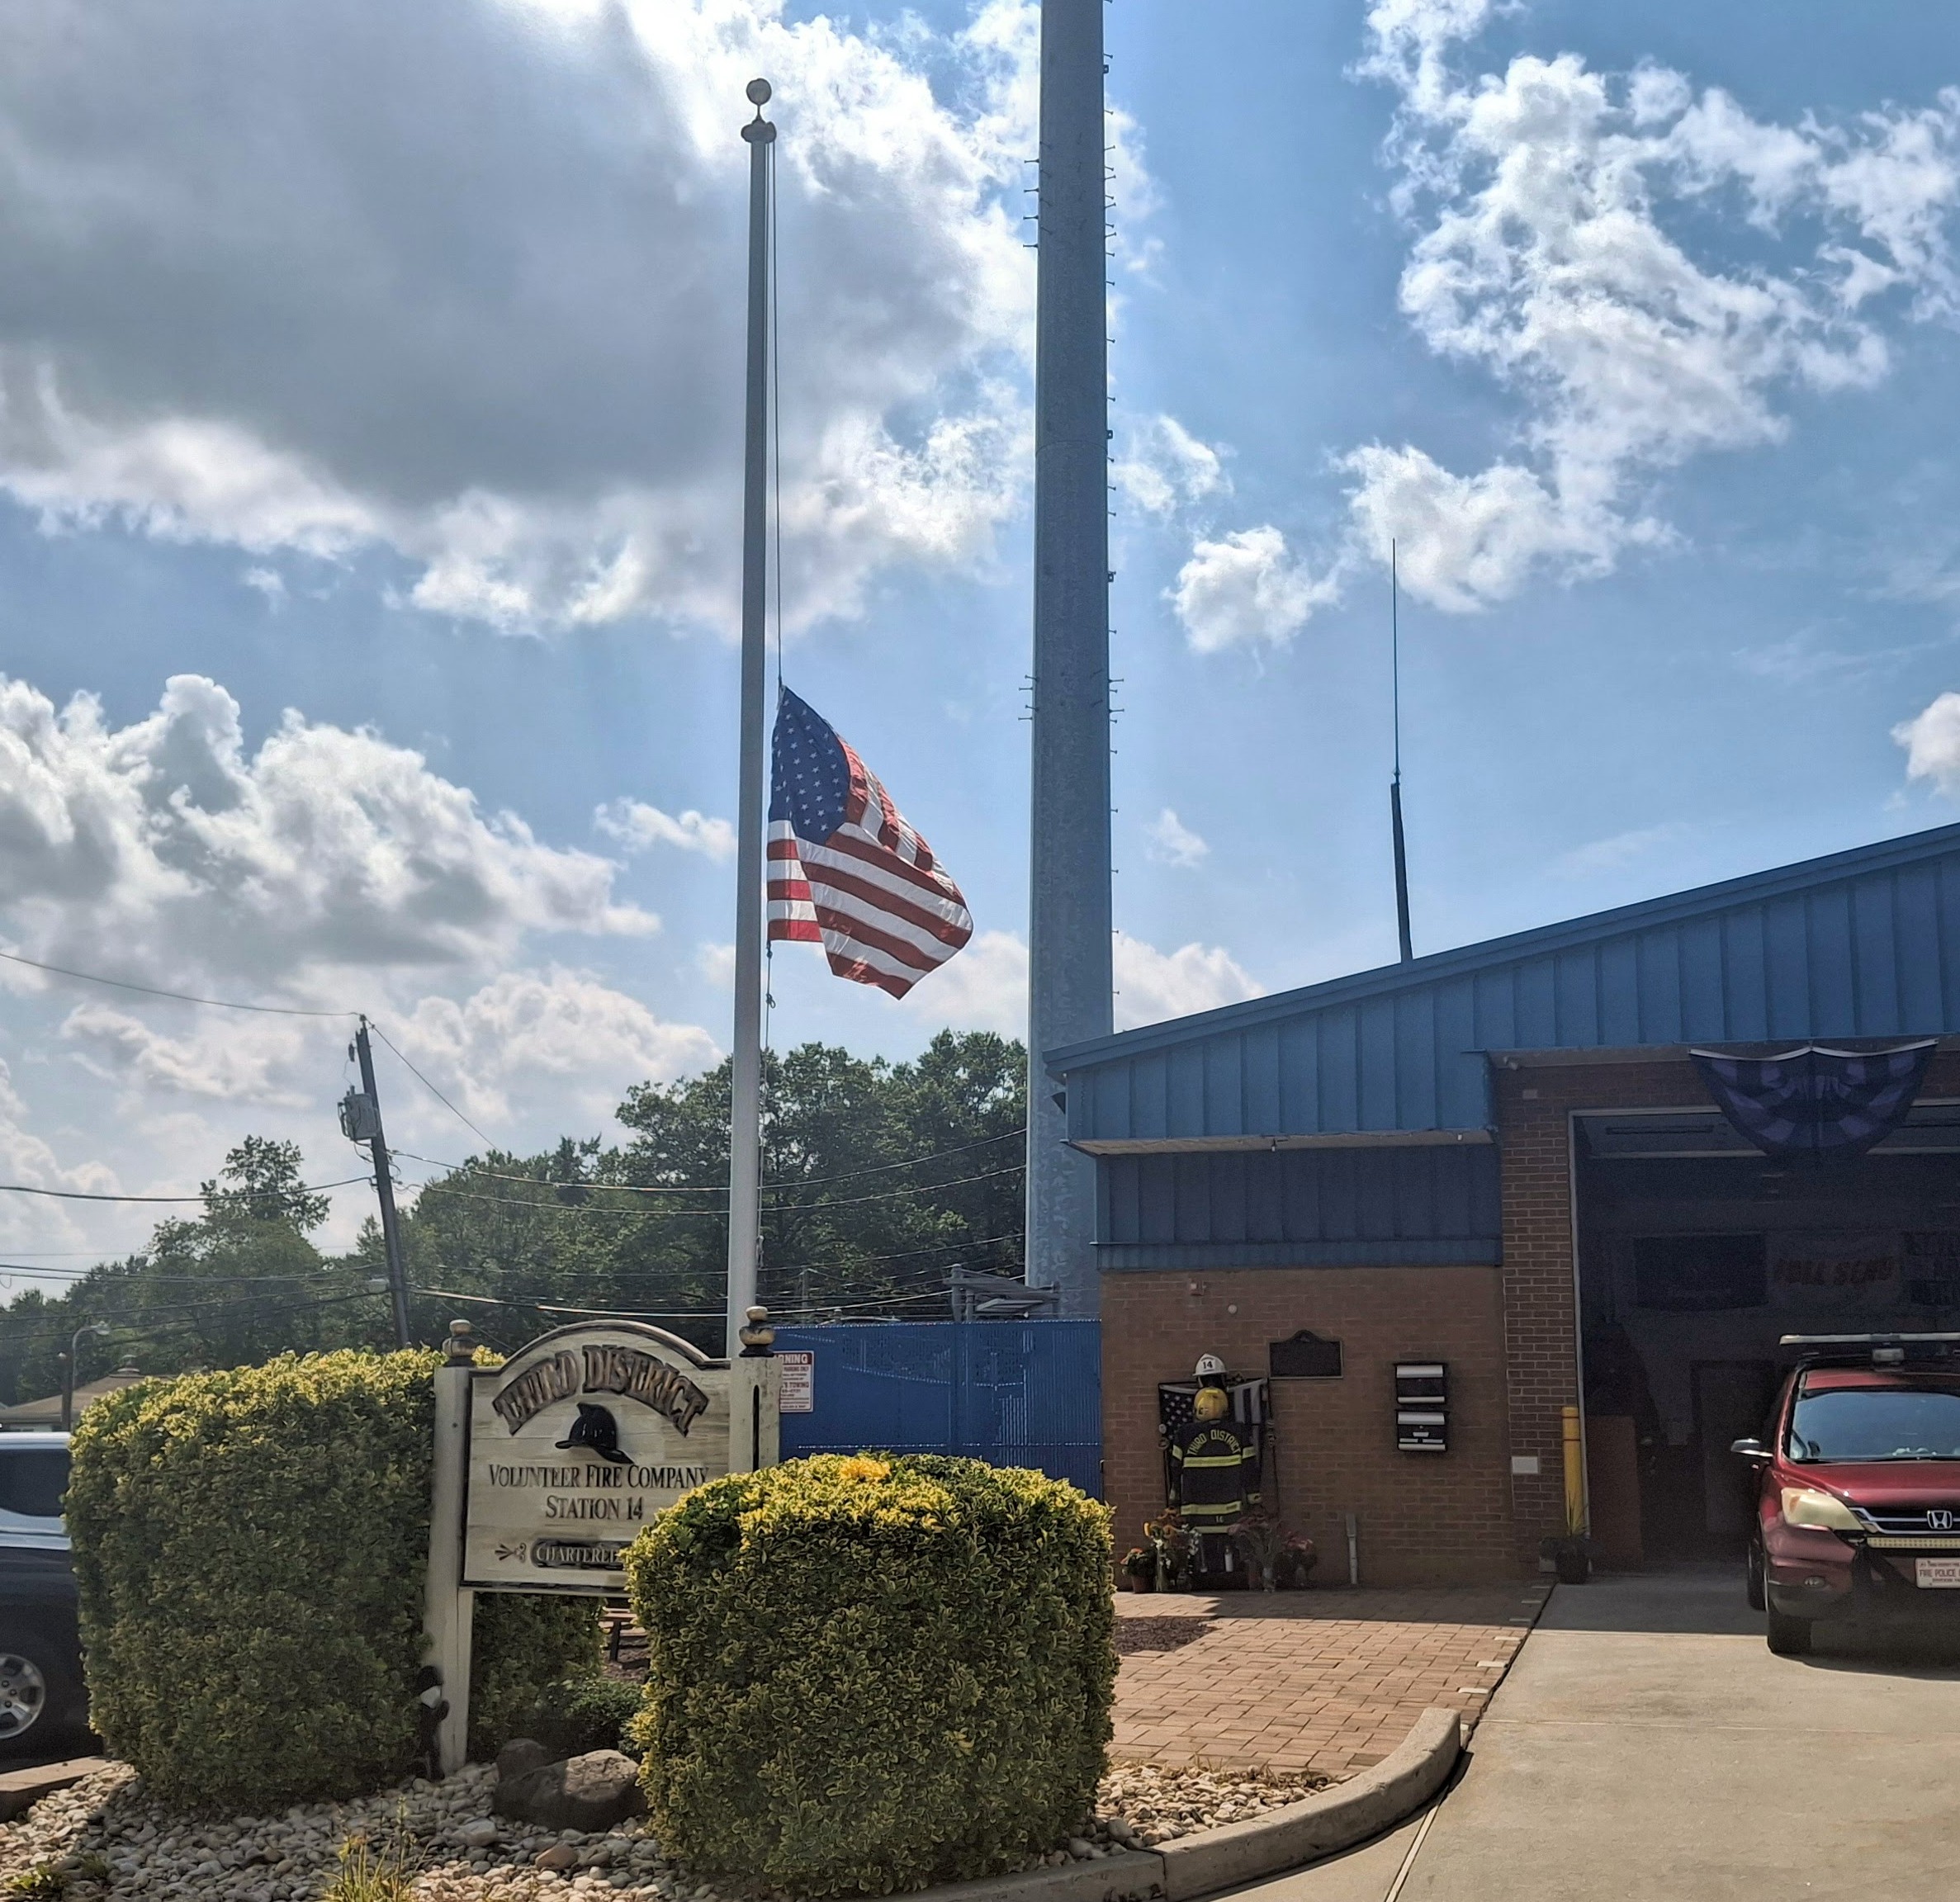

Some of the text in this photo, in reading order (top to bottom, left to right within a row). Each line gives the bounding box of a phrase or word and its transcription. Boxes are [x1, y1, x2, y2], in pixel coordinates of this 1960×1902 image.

[1203, 1360, 1213, 1369] 14
[493, 1345, 709, 1437] THIRD DISTRICT
[1186, 1429, 1241, 1455] THIRD DISTRICT
[489, 1464, 709, 1488] VOLUNTEER FIRE COMPANY
[546, 1495, 644, 1521] STATION 14
[537, 1546, 616, 1563] CHARTERE
